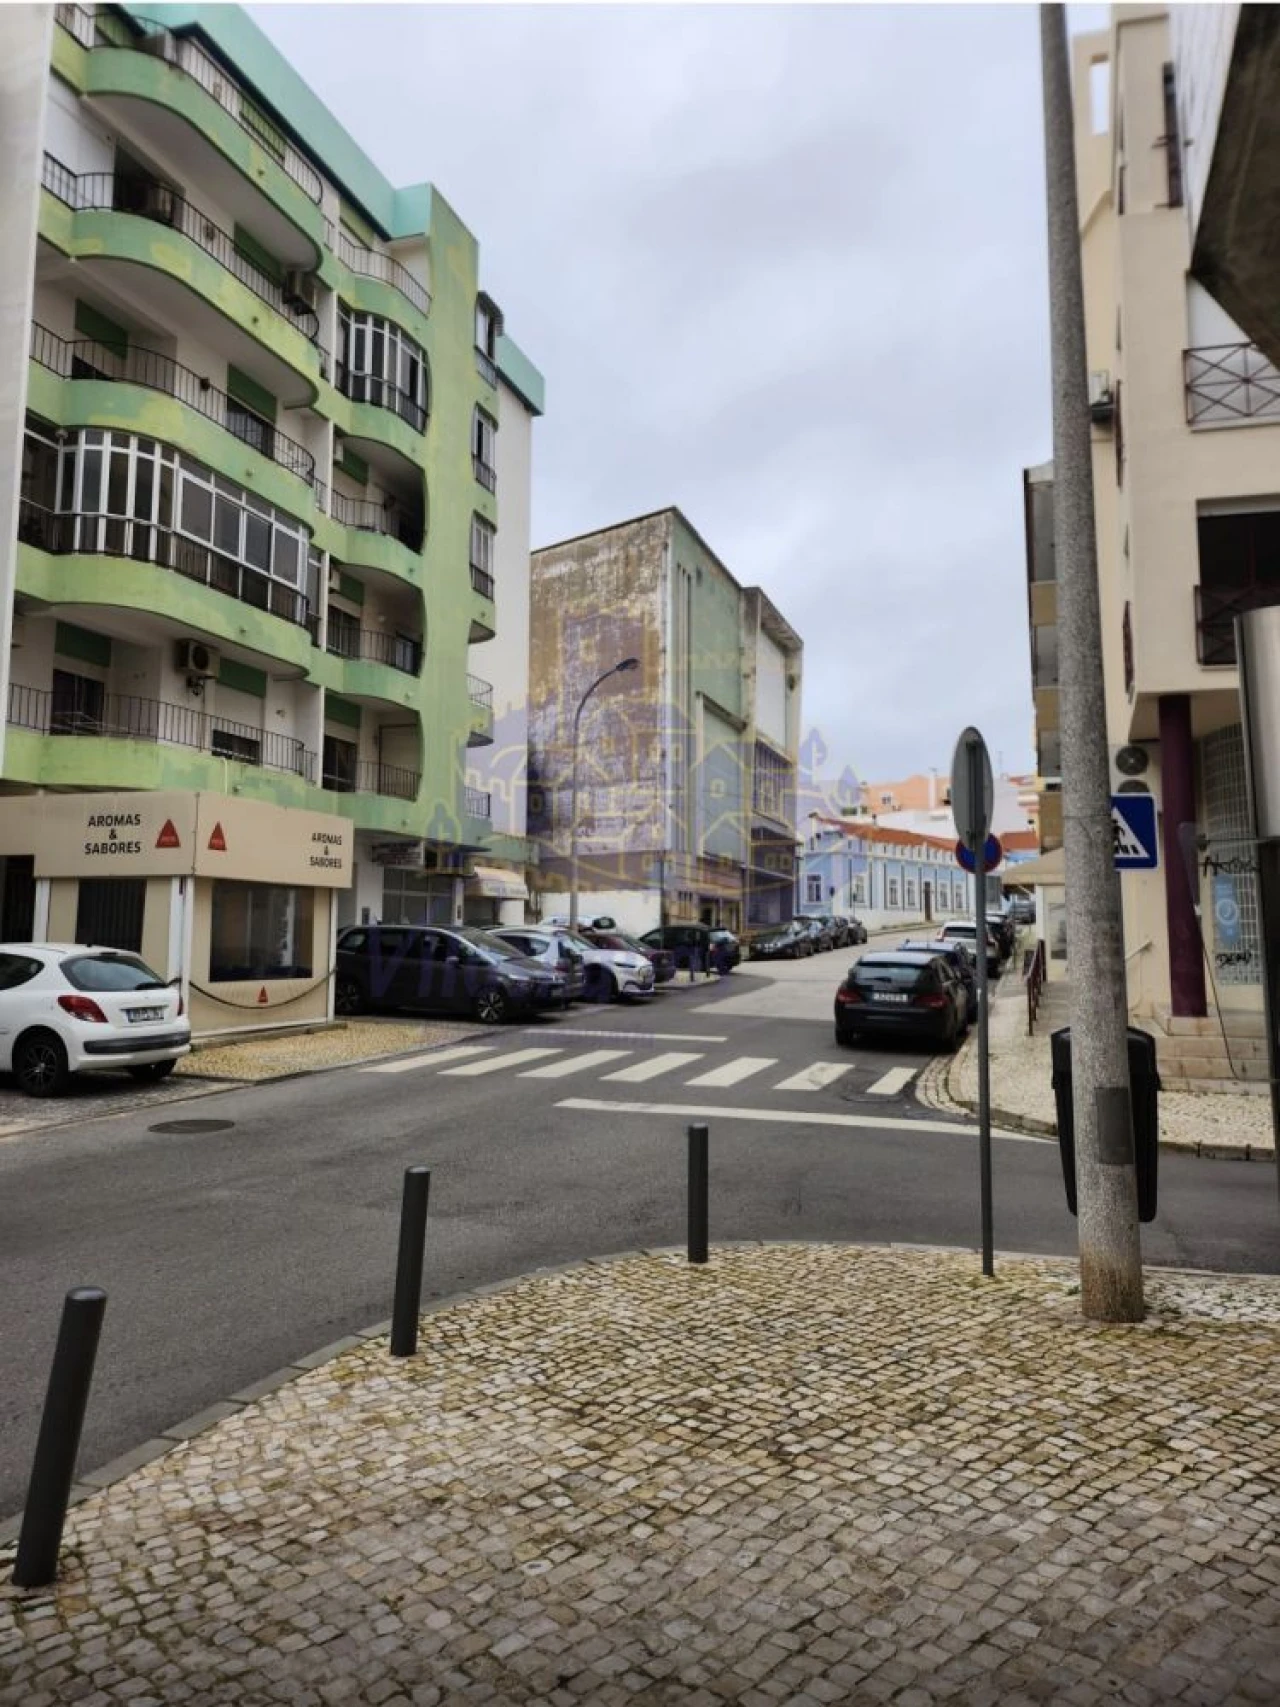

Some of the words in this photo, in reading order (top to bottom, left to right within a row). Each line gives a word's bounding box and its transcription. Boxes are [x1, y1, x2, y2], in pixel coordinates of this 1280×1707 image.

[88, 814, 141, 827] AROMAS
[109, 828, 117, 840] &
[312, 832, 342, 845] AROMAS
[84, 841, 141, 855] SABORES
[309, 856, 342, 869] SABORES
